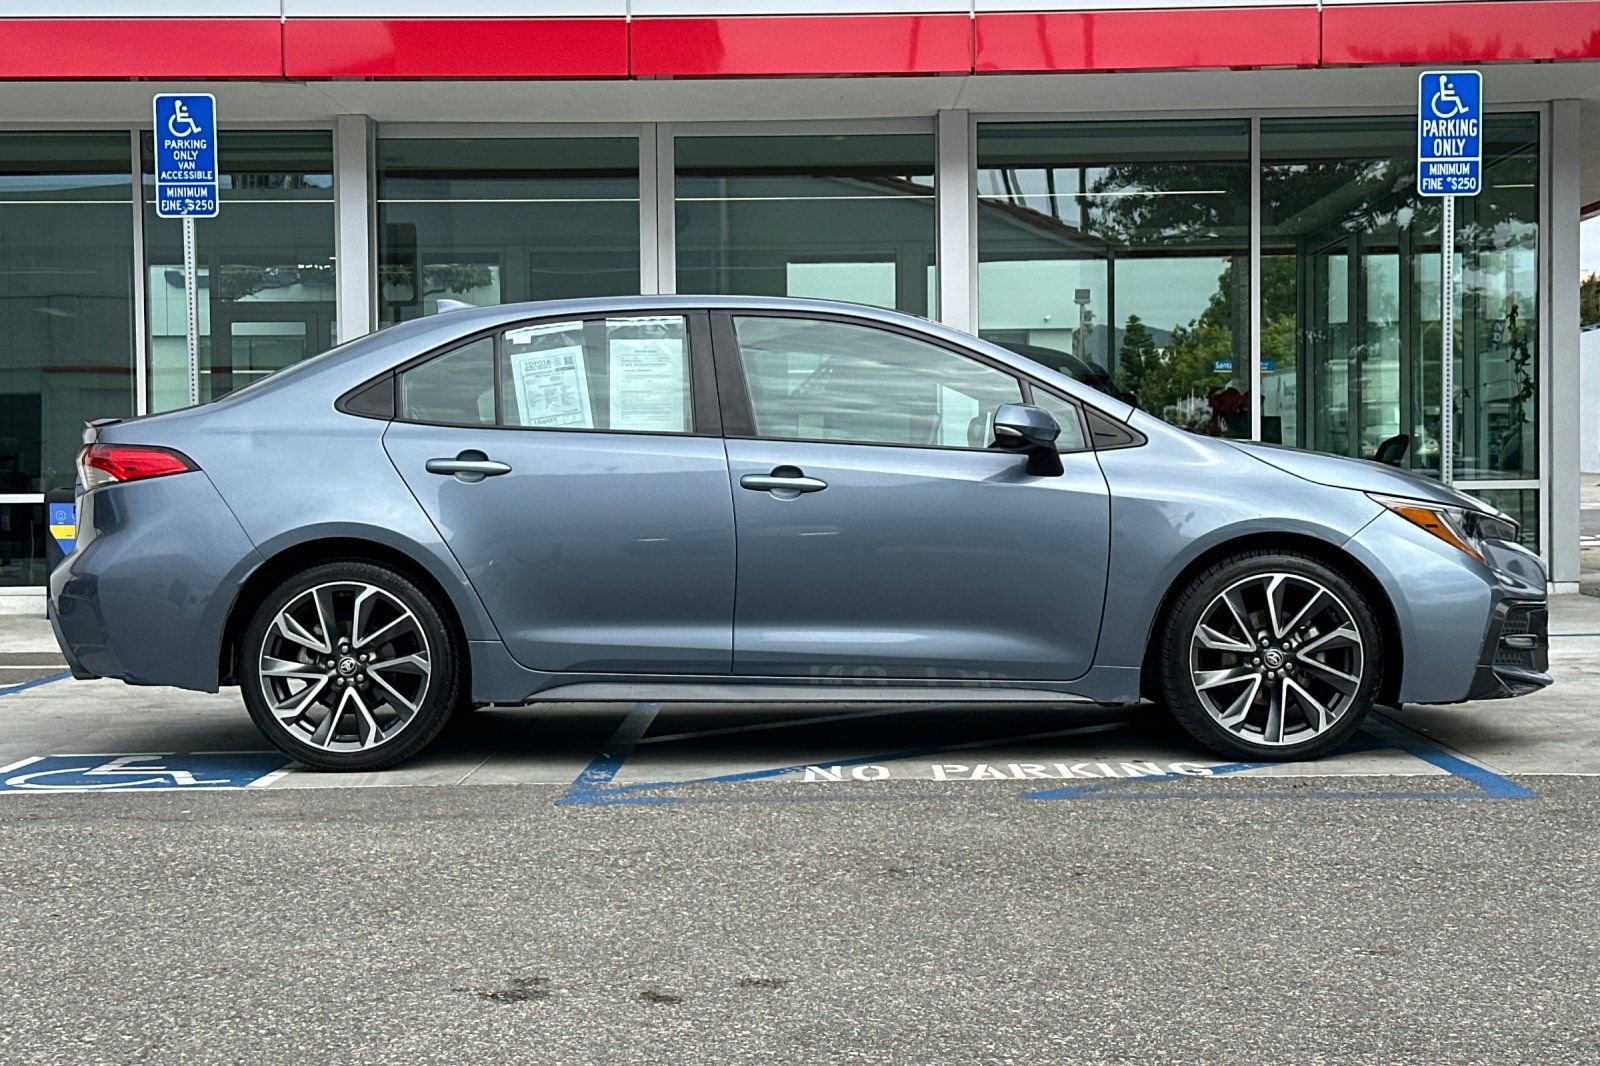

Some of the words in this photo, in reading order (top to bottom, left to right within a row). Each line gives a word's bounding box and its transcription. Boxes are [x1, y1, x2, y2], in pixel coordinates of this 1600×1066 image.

[1423, 119, 1478, 137] PARKING
[164, 139, 207, 149] PARKING
[1433, 138, 1466, 156] ONLY
[173, 150, 198, 160] ONLY
[178, 161, 195, 170] VAN
[1429, 163, 1470, 175] MINIMUM
[160, 171, 213, 180] ACCESSIBLE
[1422, 177, 1443, 190] FINE
[1451, 177, 1476, 190] $250
[166, 187, 208, 198] MINIMUM
[161, 200, 182, 211] FINE
[186, 200, 214, 211] $250
[804, 765, 890, 782] NO
[931, 762, 1214, 782] PARKING
